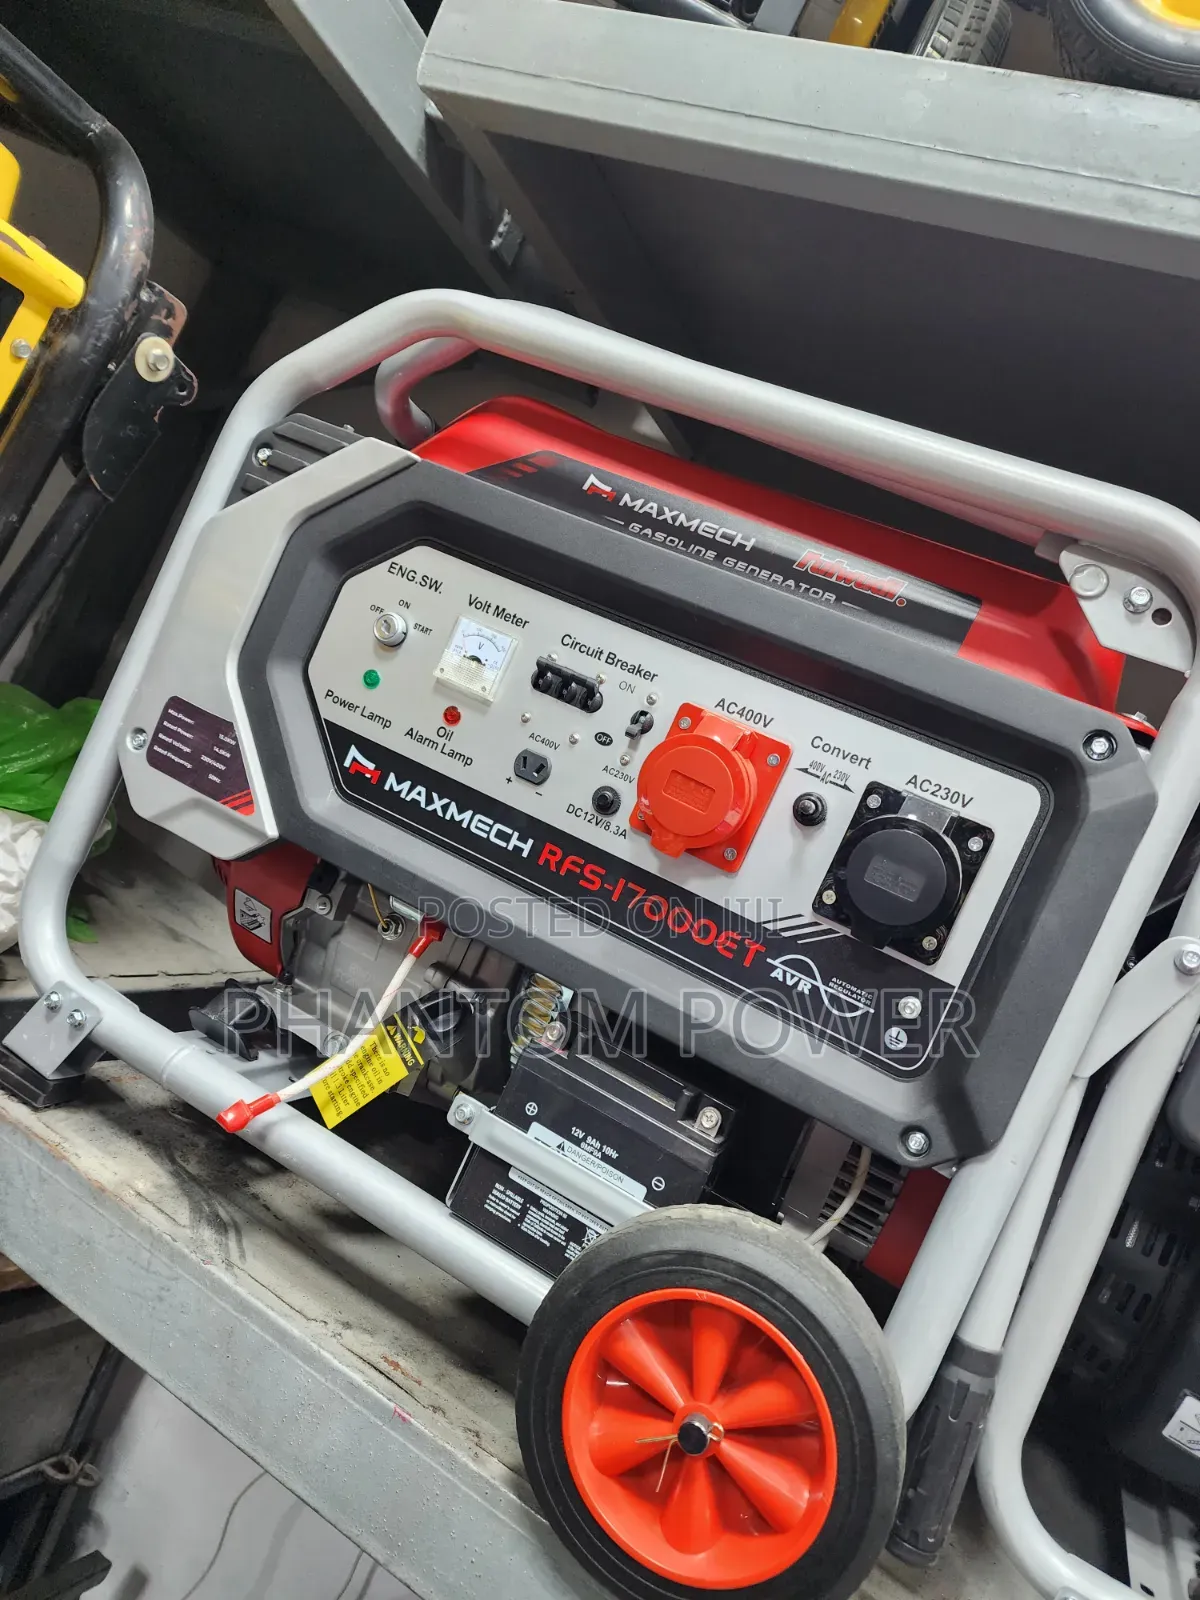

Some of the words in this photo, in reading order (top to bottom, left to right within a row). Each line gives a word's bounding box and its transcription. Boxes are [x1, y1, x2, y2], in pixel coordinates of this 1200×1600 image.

[619, 493, 756, 551] MAXMECH
[628, 522, 717, 562] GASOLINE
[722, 557, 837, 604] GENERATOR
[387, 561, 443, 595] ENG.SW.
[369, 604, 385, 615] OFF
[398, 599, 412, 610] ON
[467, 594, 495, 617] Volt
[492, 604, 531, 630] Meter
[412, 622, 433, 637] START
[560, 634, 605, 661] Circuit
[604, 652, 659, 683] Breaker
[618, 680, 637, 695] ON
[324, 689, 362, 715] Power
[358, 705, 393, 731] Lamp
[714, 698, 775, 730] AC400V
[404, 727, 440, 753] Alarm
[439, 742, 474, 768] Lamp
[436, 726, 454, 742] Oil
[528, 731, 561, 751] AC400V
[596, 732, 612, 746] OFF
[809, 735, 873, 770] Convert
[601, 765, 636, 785] AC230V
[808, 759, 826, 774] 400V
[819, 770, 832, 784] AC
[832, 768, 851, 784] 230V
[905, 773, 975, 810] AC230V
[566, 803, 628, 840] DC12V/8.3A
[383, 772, 533, 858] MAXMECH
[538, 842, 767, 969] RFS-17000ET
[769, 967, 813, 996] AVR
[828, 981, 872, 1006] REGULATOR
[831, 976, 874, 1000] AUTOMATIC
[370, 1042, 381, 1059] There
[394, 1032, 415, 1066] WARNING
[350, 1069, 368, 1098] specified
[371, 1067, 380, 1077] oil
[376, 1076, 383, 1084] in
[328, 1091, 342, 1116] starting.
[346, 1084, 360, 1106] engine
[571, 1126, 585, 1139] 12V
[586, 1134, 602, 1147] 9Ah
[601, 1143, 619, 1159] 10Hr
[566, 1145, 625, 1184] DANGER/POISON
